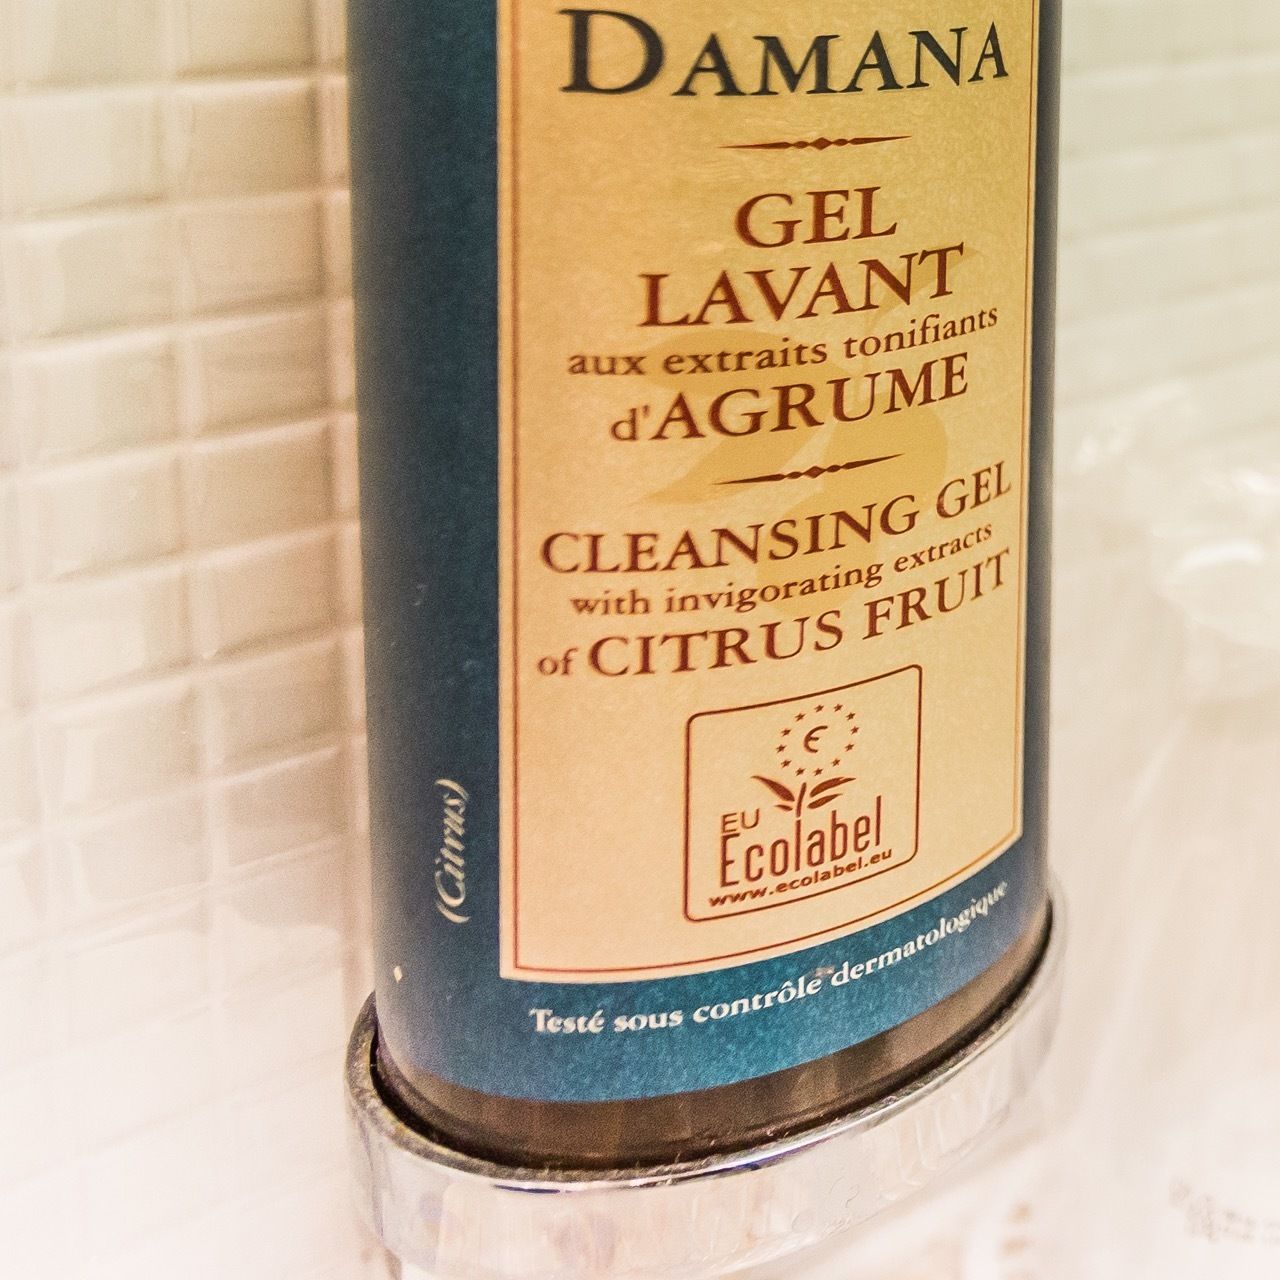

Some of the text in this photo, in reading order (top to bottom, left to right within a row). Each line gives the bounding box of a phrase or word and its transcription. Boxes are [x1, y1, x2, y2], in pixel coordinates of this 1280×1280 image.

[734, 186, 897, 249] GEL
[637, 242, 964, 328] LAVANT
[568, 306, 999, 377] aux extraits tonifiants
[609, 352, 968, 442] d'AGRUME
[540, 460, 1012, 574] CLEANSING GEL
[536, 549, 1011, 678] of CITRUS FRUIT
[569, 522, 993, 616] with invigorating extracts
[719, 795, 882, 888] Ecolabel
[720, 808, 761, 834] EU
[708, 848, 893, 908] www.ecolabel.eu
[529, 880, 1009, 1034] Testé sous contrôle dermatologique
